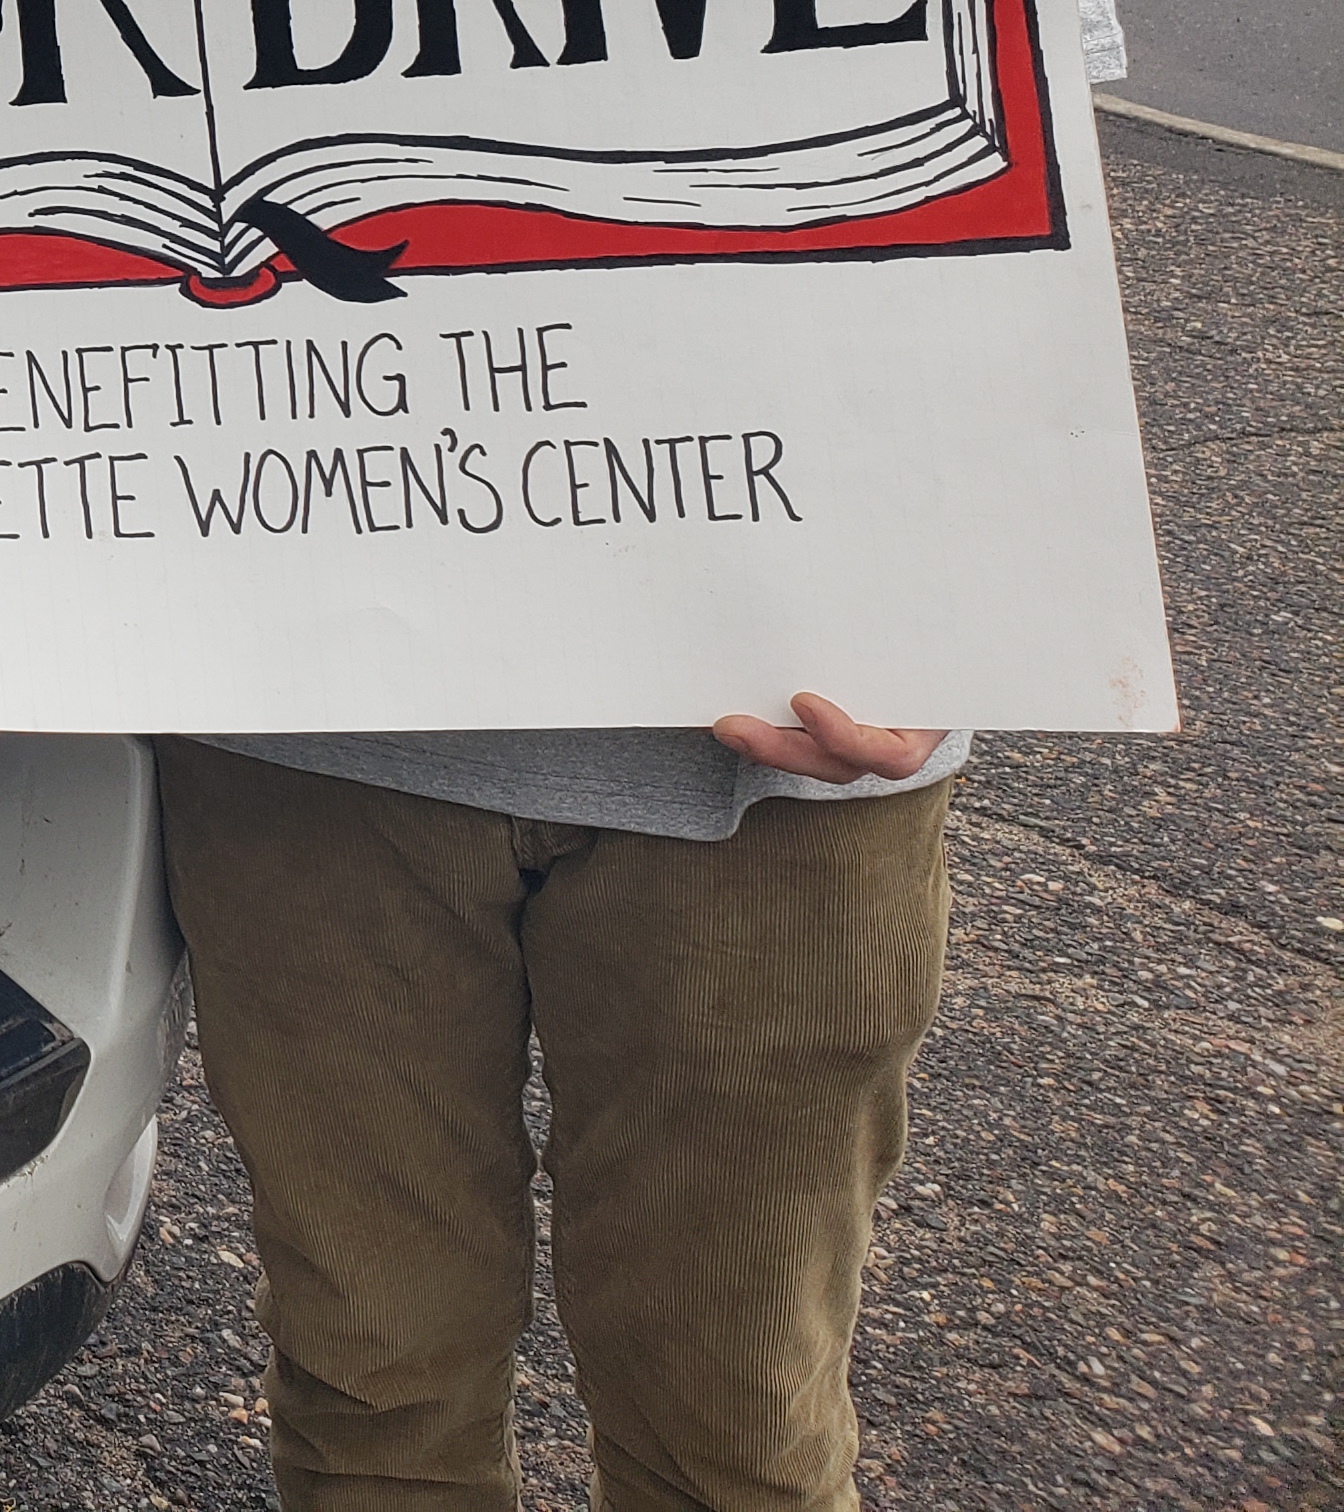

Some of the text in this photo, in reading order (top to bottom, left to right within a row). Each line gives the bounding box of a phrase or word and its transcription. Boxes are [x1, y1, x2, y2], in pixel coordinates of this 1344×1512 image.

[438, 322, 588, 413] THE
[174, 427, 504, 537] WOMEN'S
[520, 429, 803, 528] CENTER
